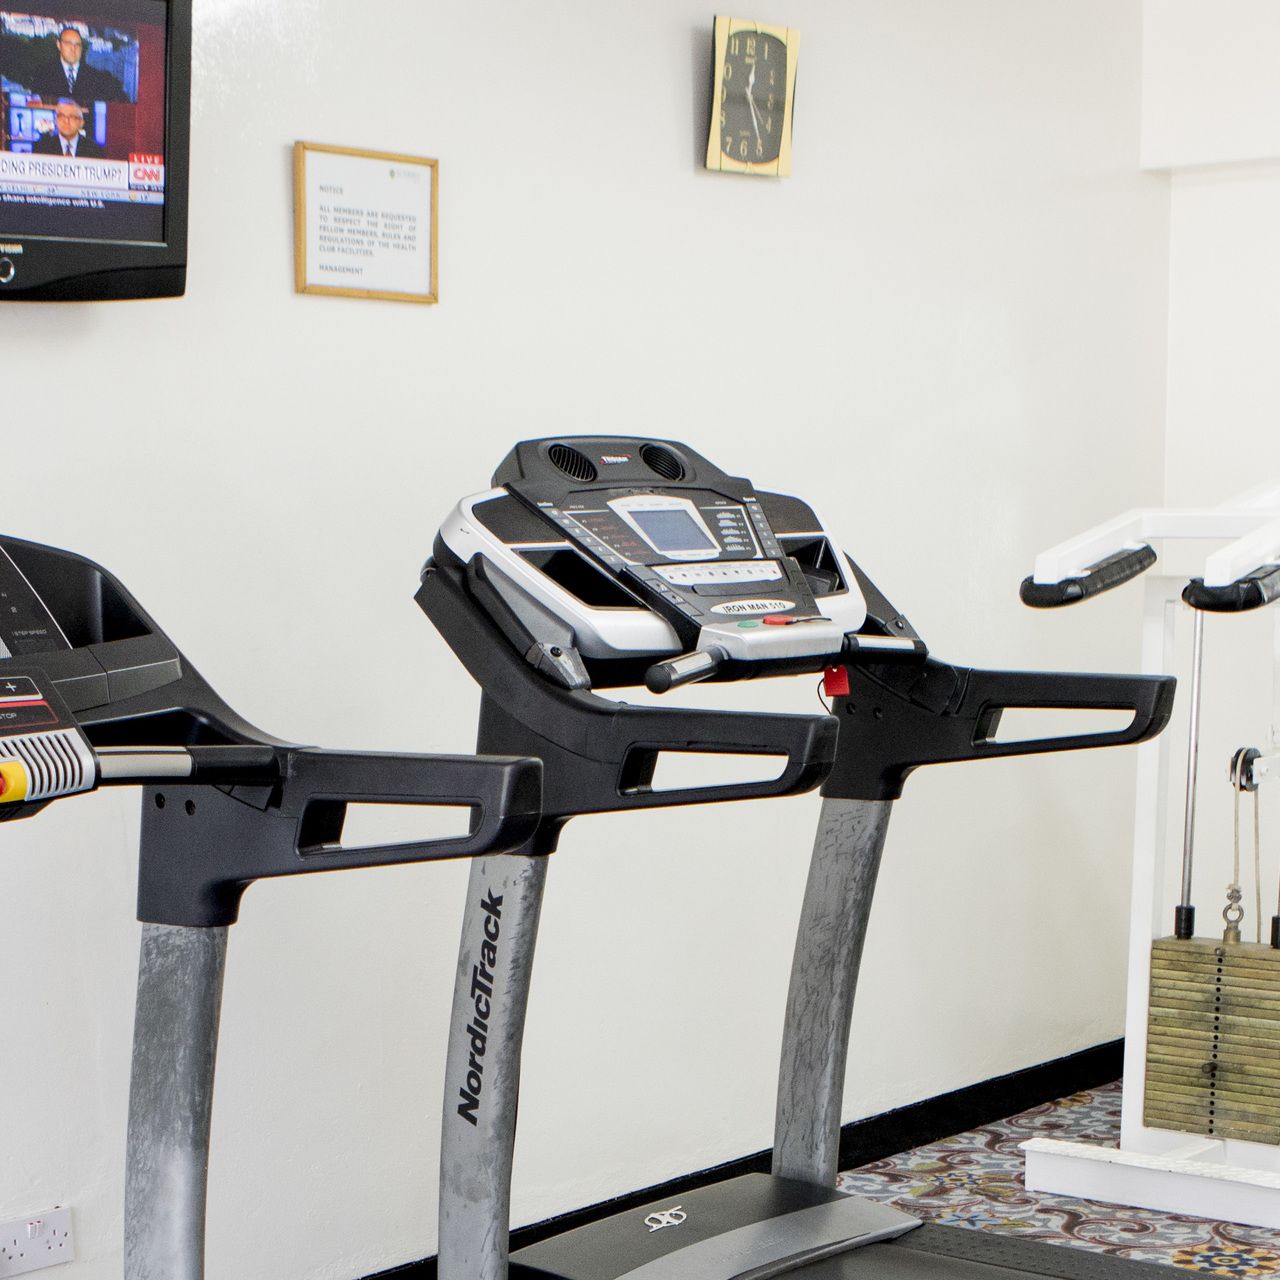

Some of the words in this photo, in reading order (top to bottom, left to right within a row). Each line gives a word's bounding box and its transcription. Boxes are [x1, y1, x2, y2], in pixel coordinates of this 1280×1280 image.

[133, 155, 160, 164] LIVE
[29, 162, 81, 179] PRESIDENT
[84, 166, 122, 182] TRUMP?
[133, 168, 161, 182] CNN
[319, 185, 343, 194] NOTICE
[320, 205, 330, 213] ALL
[333, 207, 364, 216] MEMBERS
[381, 212, 417, 222] REQUESTED
[334, 217, 361, 226] RESPECT
[367, 220, 378, 228] THE
[320, 225, 344, 234] FELLOW
[320, 235, 364, 245] REGULATIONS
[320, 245, 336, 253] CLUB
[319, 264, 363, 274] MANAGEMENT
[722, 605, 747, 614] IRON
[748, 603, 768, 611] MAN
[457, 888, 504, 1127] NordicTrack
